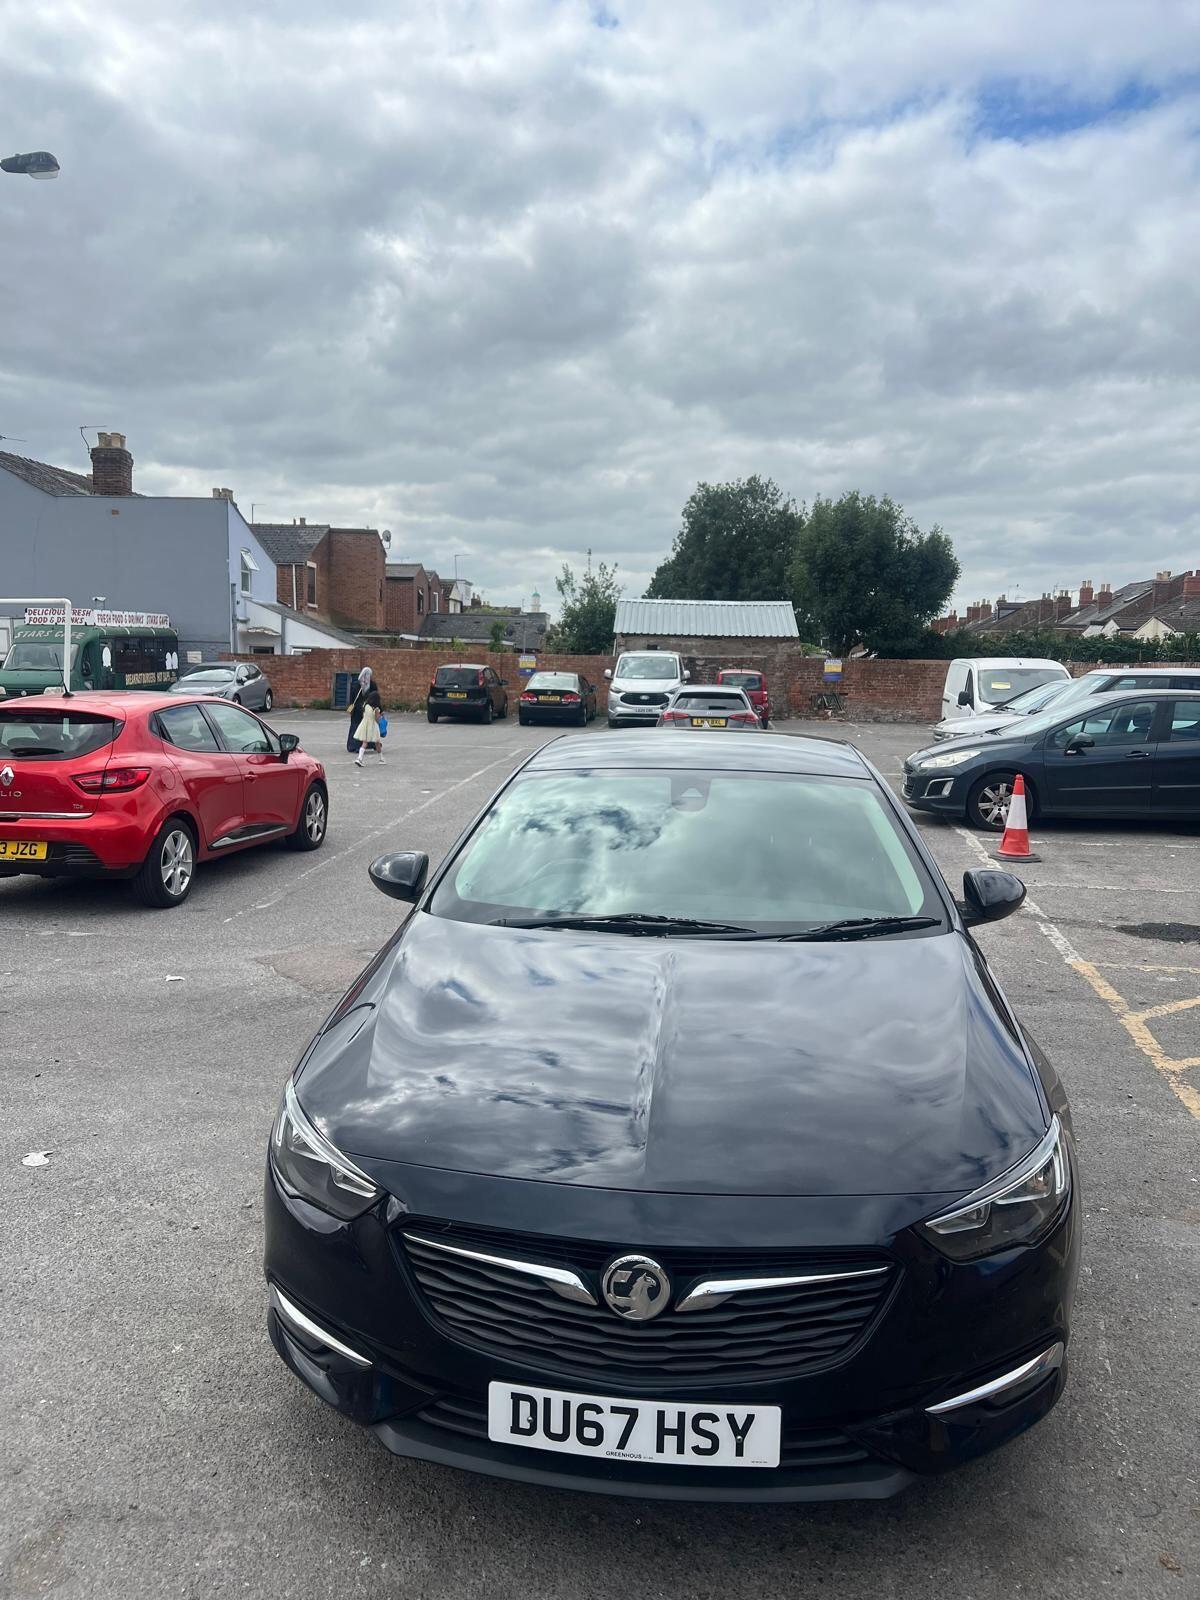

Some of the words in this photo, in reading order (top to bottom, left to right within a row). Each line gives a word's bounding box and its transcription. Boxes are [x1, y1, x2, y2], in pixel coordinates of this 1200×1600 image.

[28, 608, 65, 616] DELICIOUS
[71, 609, 91, 617] RESH
[28, 616, 48, 624] FOOD
[56, 616, 85, 625] DRNKS
[97, 613, 111, 624] FRESH
[112, 614, 123, 625] FOOD
[128, 615, 144, 625] DRINKS
[14, 630, 53, 639] STARS
[11, 842, 38, 856] JZG
[510, 1391, 639, 1450] DU67
[656, 1410, 756, 1458] HSY
